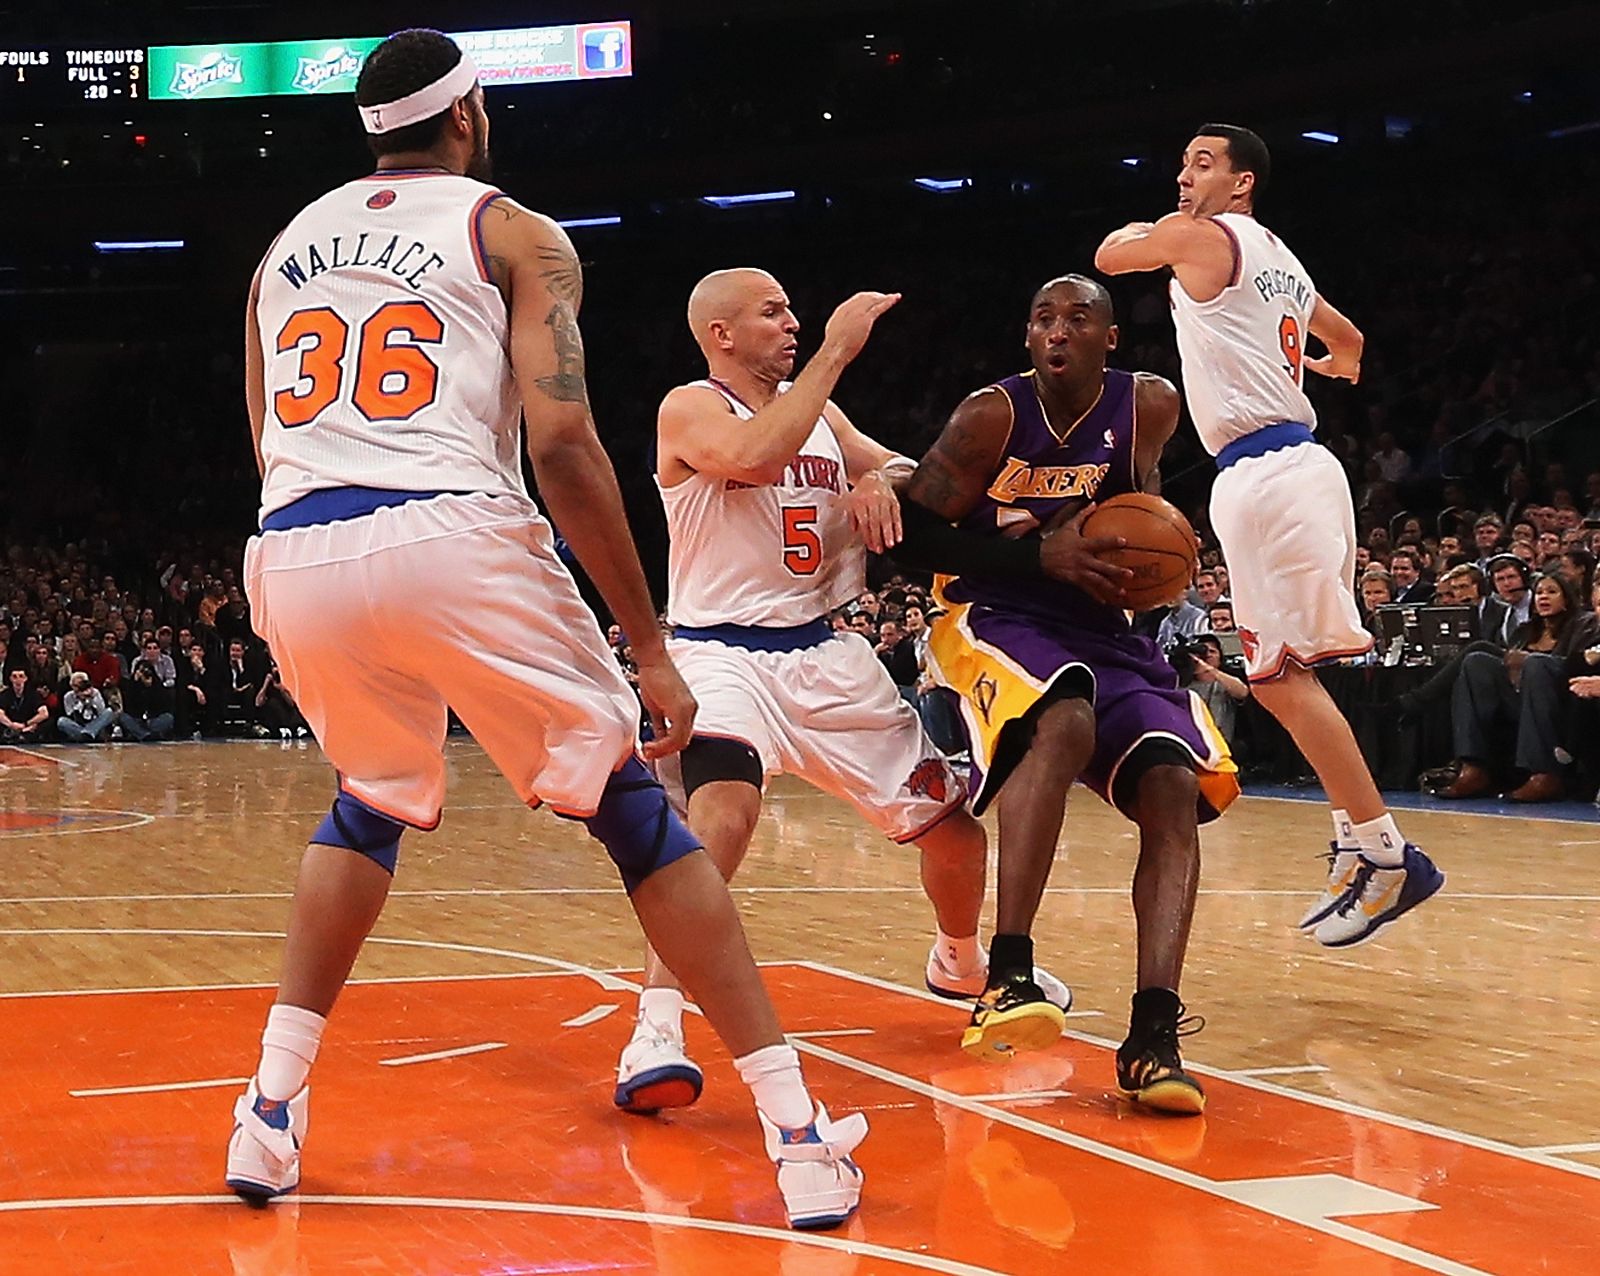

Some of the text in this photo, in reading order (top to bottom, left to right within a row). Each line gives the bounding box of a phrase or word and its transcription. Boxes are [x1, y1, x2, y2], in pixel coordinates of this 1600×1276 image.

[0, 51, 49, 65] FOULS
[66, 49, 143, 64] TIMEOUTS
[302, 55, 359, 86] Sprite
[17, 67, 25, 81] 1
[68, 67, 108, 81] FULL
[129, 65, 139, 80] 3
[178, 61, 235, 91] Sprite
[84, 85, 108, 99] :20
[130, 83, 138, 98] 1
[278, 232, 444, 291] WALLACE
[1279, 313, 1303, 385] 9
[274, 300, 445, 429] 36
[986, 456, 1111, 503] LAKERS
[782, 505, 823, 577] 5
